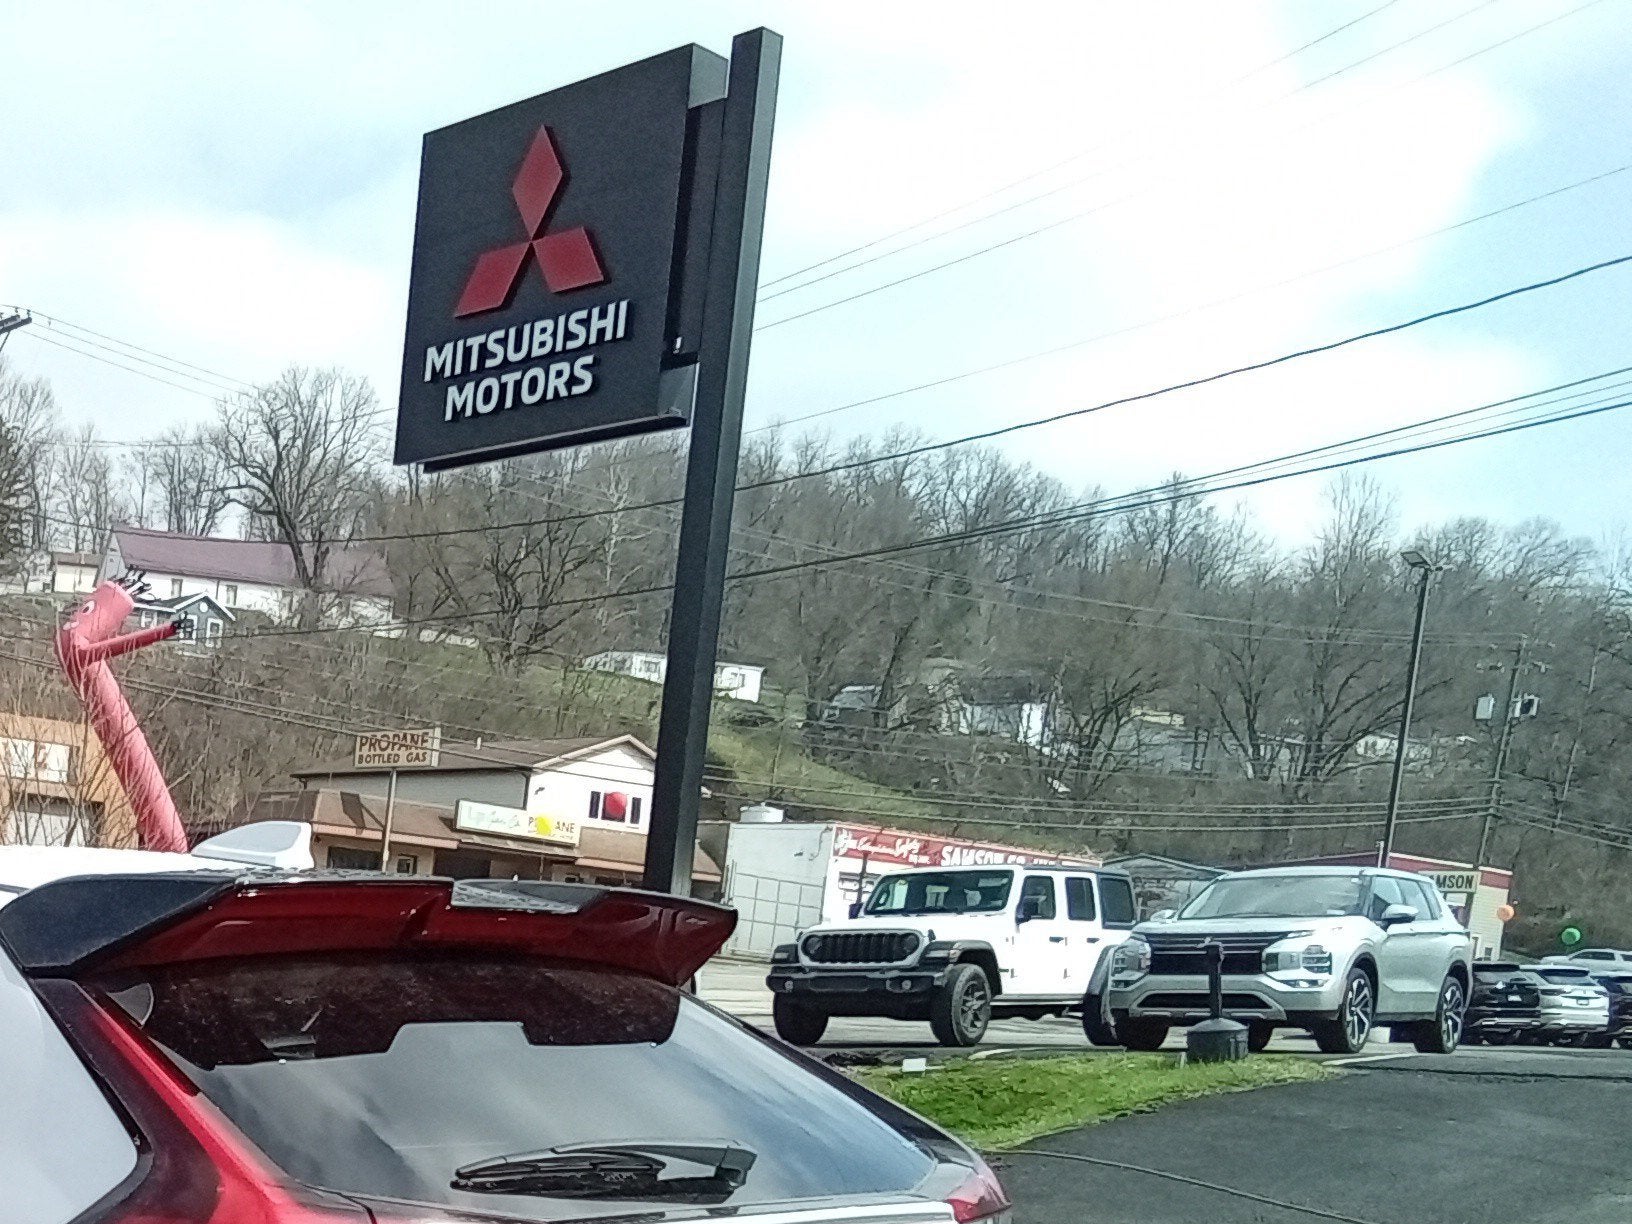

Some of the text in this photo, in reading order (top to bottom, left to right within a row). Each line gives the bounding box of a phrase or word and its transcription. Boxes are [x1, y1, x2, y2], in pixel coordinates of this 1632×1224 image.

[423, 299, 630, 383] MITSUBISHI
[444, 354, 595, 422] MOTORS
[359, 731, 429, 752] PROPANE
[358, 752, 427, 764] BOTTLED GAS
[1429, 874, 1474, 889] MSON
